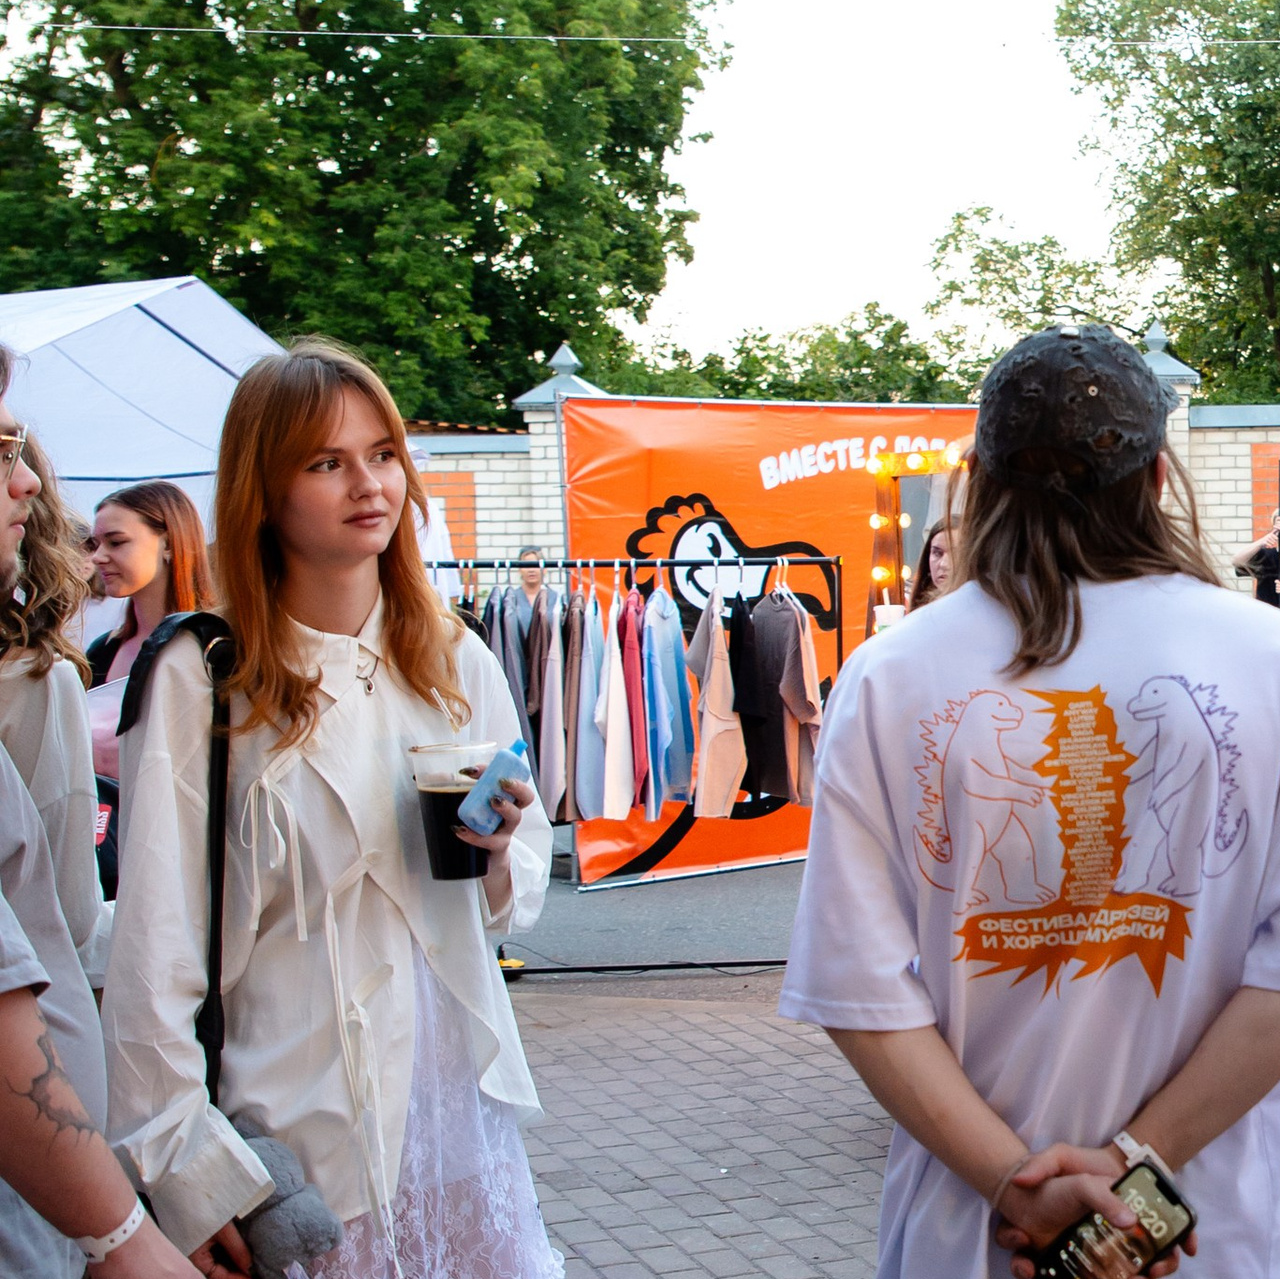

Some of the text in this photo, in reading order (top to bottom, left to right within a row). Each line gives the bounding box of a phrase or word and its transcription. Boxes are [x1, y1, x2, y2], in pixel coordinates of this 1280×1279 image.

[759, 436, 866, 490] ВМЕСТЕ
[978, 903, 1170, 933] ФЕСТИВА ДРЗЕЙ
[981, 934, 998, 950] И
[1124, 1187, 1168, 1240] 19:20
